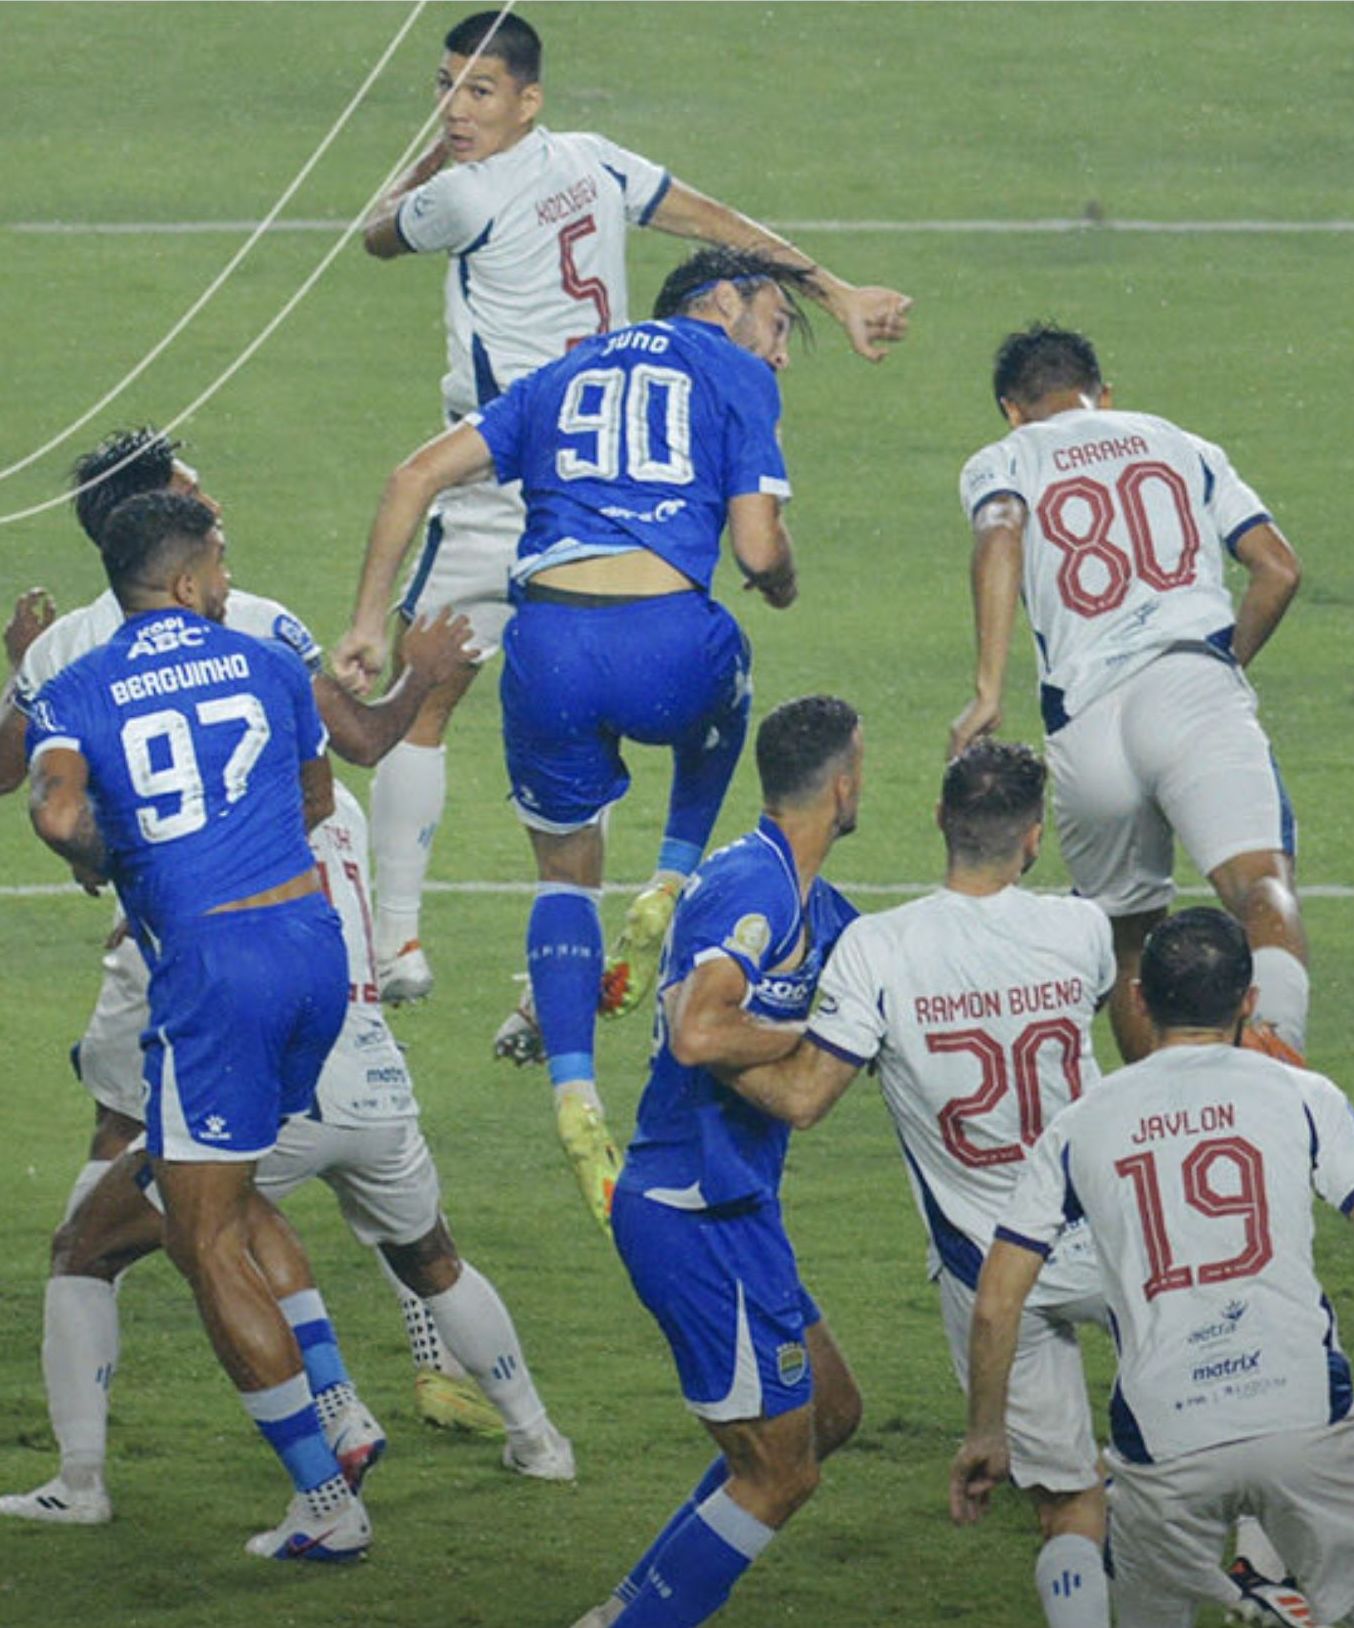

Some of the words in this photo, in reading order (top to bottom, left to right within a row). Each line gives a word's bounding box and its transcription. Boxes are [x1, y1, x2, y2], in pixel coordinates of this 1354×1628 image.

[558, 213, 611, 350] 5
[602, 330, 669, 356] JUNO
[556, 363, 694, 485] 90
[1053, 435, 1150, 472] CARAKA
[1035, 461, 1200, 620] 80
[137, 616, 185, 641] KOPI
[110, 653, 250, 706] BERGUINHO
[120, 692, 271, 844] 97
[914, 990, 1001, 1025] RAMON
[1008, 977, 1082, 1015] BUENO
[925, 1016, 1082, 1168] 20
[1131, 1103, 1235, 1144] JAVLON
[1114, 1136, 1273, 1302] 19
